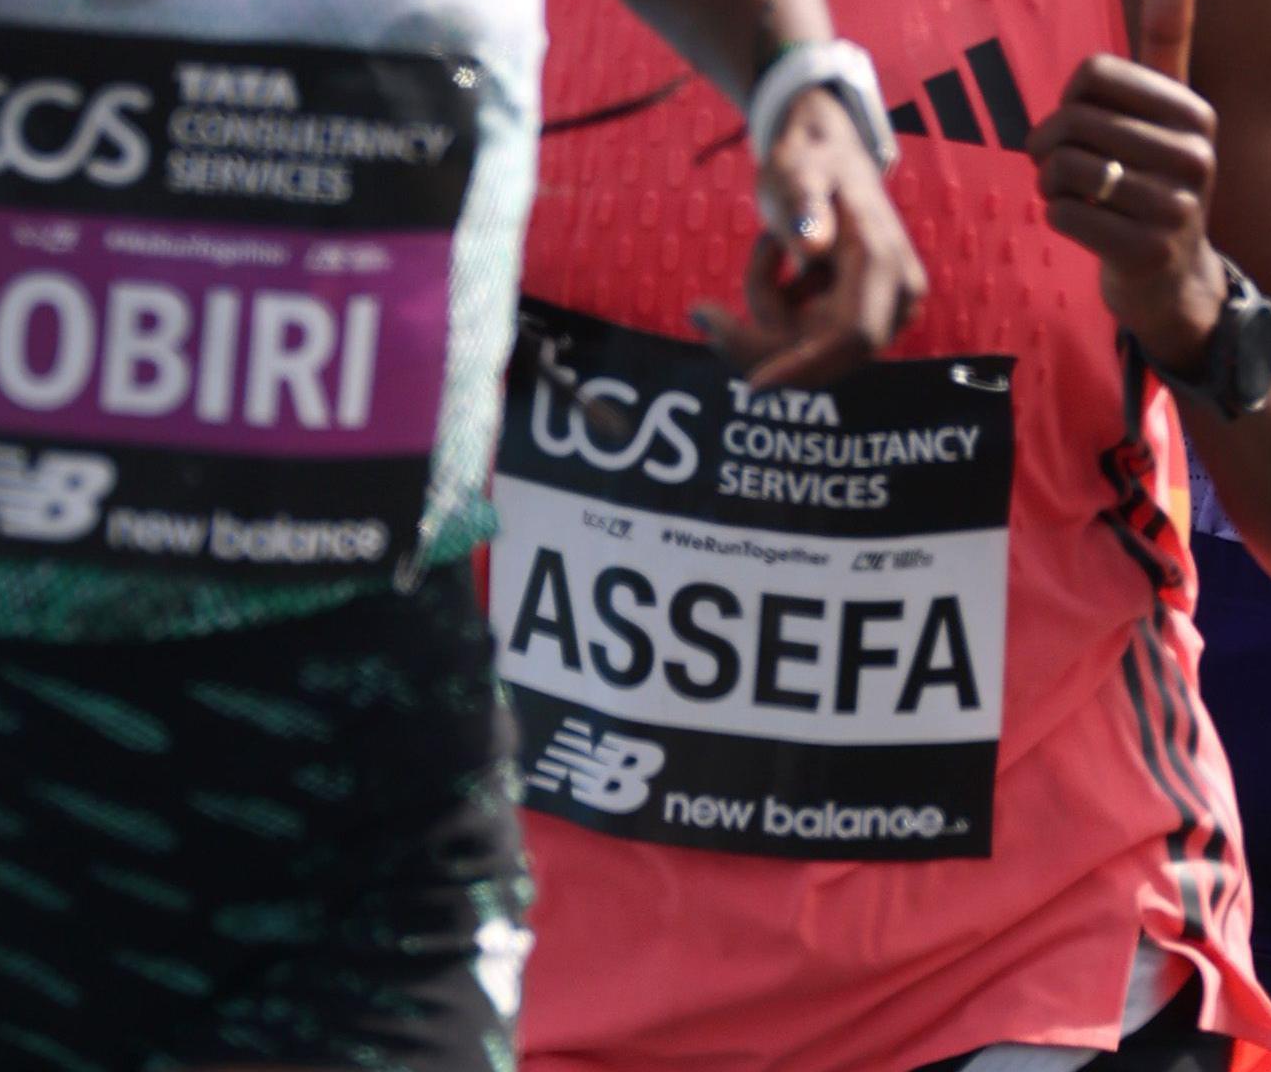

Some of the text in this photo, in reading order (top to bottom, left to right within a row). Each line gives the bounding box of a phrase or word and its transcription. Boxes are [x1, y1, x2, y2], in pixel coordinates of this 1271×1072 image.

[176, 61, 298, 110] TATA
[168, 108, 454, 164] CONSULTANCY
[166, 150, 353, 204] SERVICES
[728, 379, 839, 426] TATA
[722, 421, 978, 468] CONSULTANCY
[719, 461, 889, 508] SERVICES
[106, 506, 388, 562] new balance
[508, 545, 982, 717] ASSEFA
[664, 792, 944, 839] new balance
